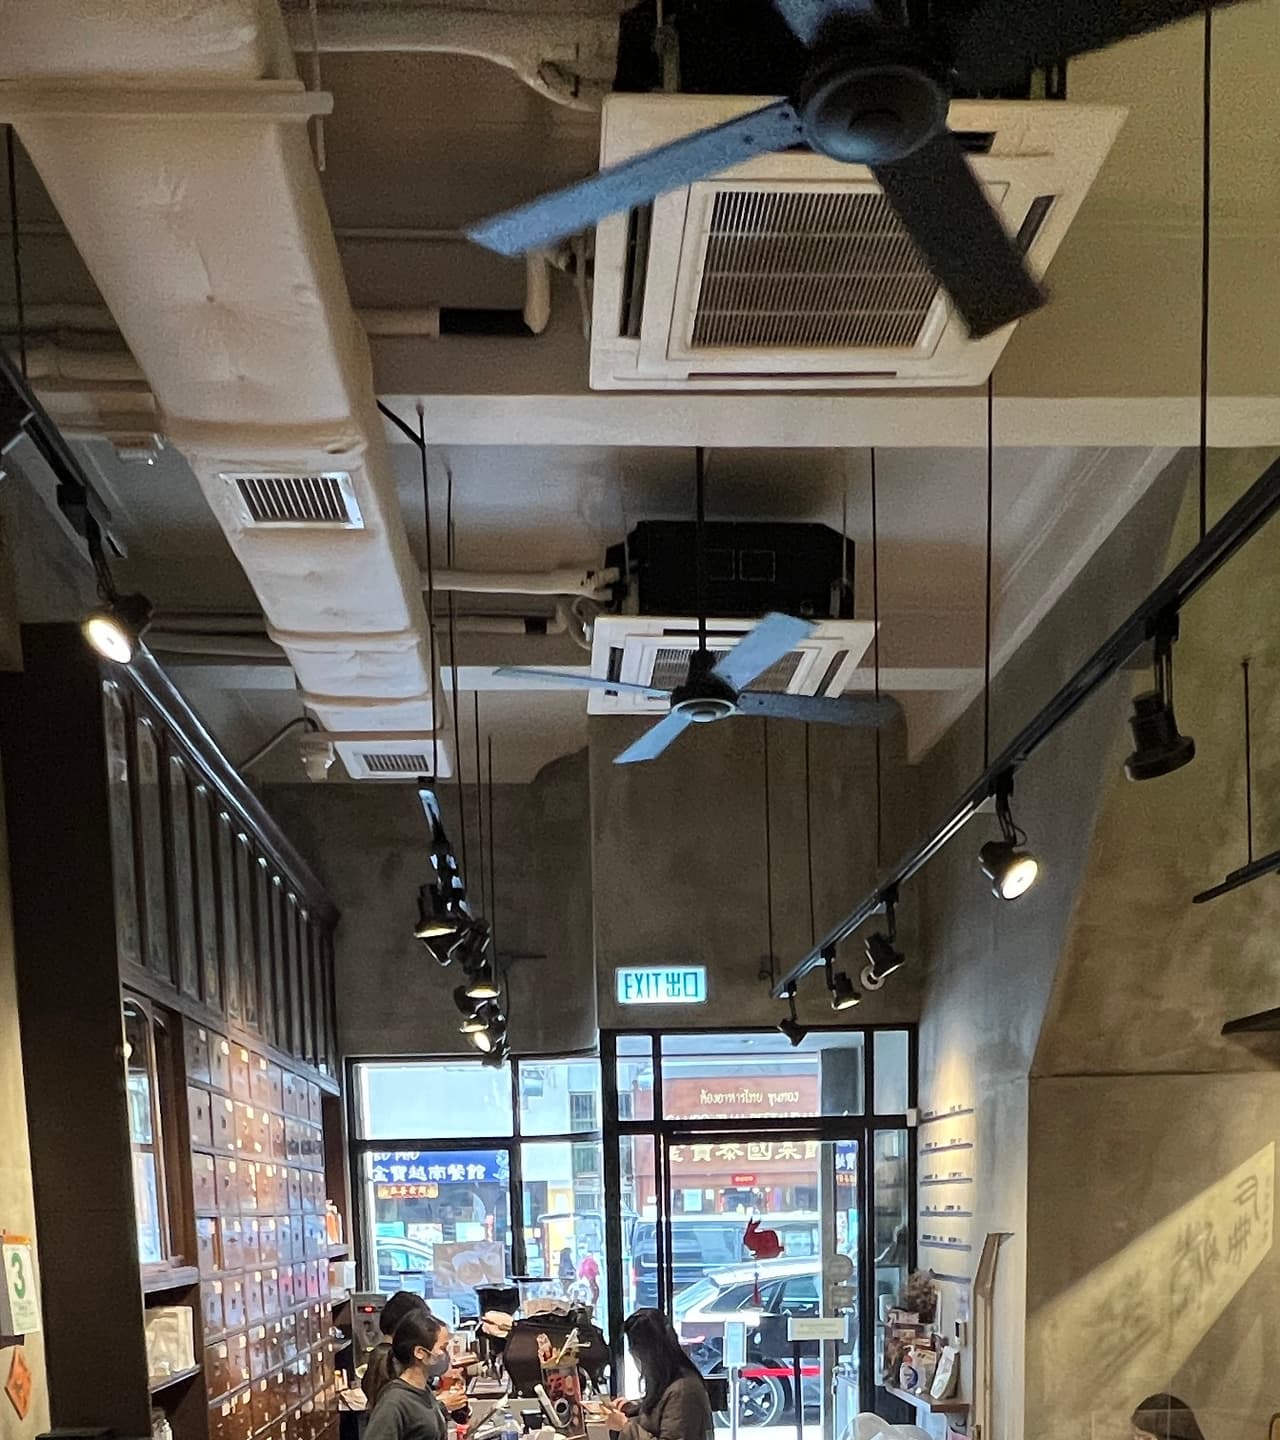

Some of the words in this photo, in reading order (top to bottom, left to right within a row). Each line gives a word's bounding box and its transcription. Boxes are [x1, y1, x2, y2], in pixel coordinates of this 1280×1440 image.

[624, 971, 662, 1000] EXIT
[666, 971, 699, 998] 出口
[11, 1252, 26, 1300] 3
